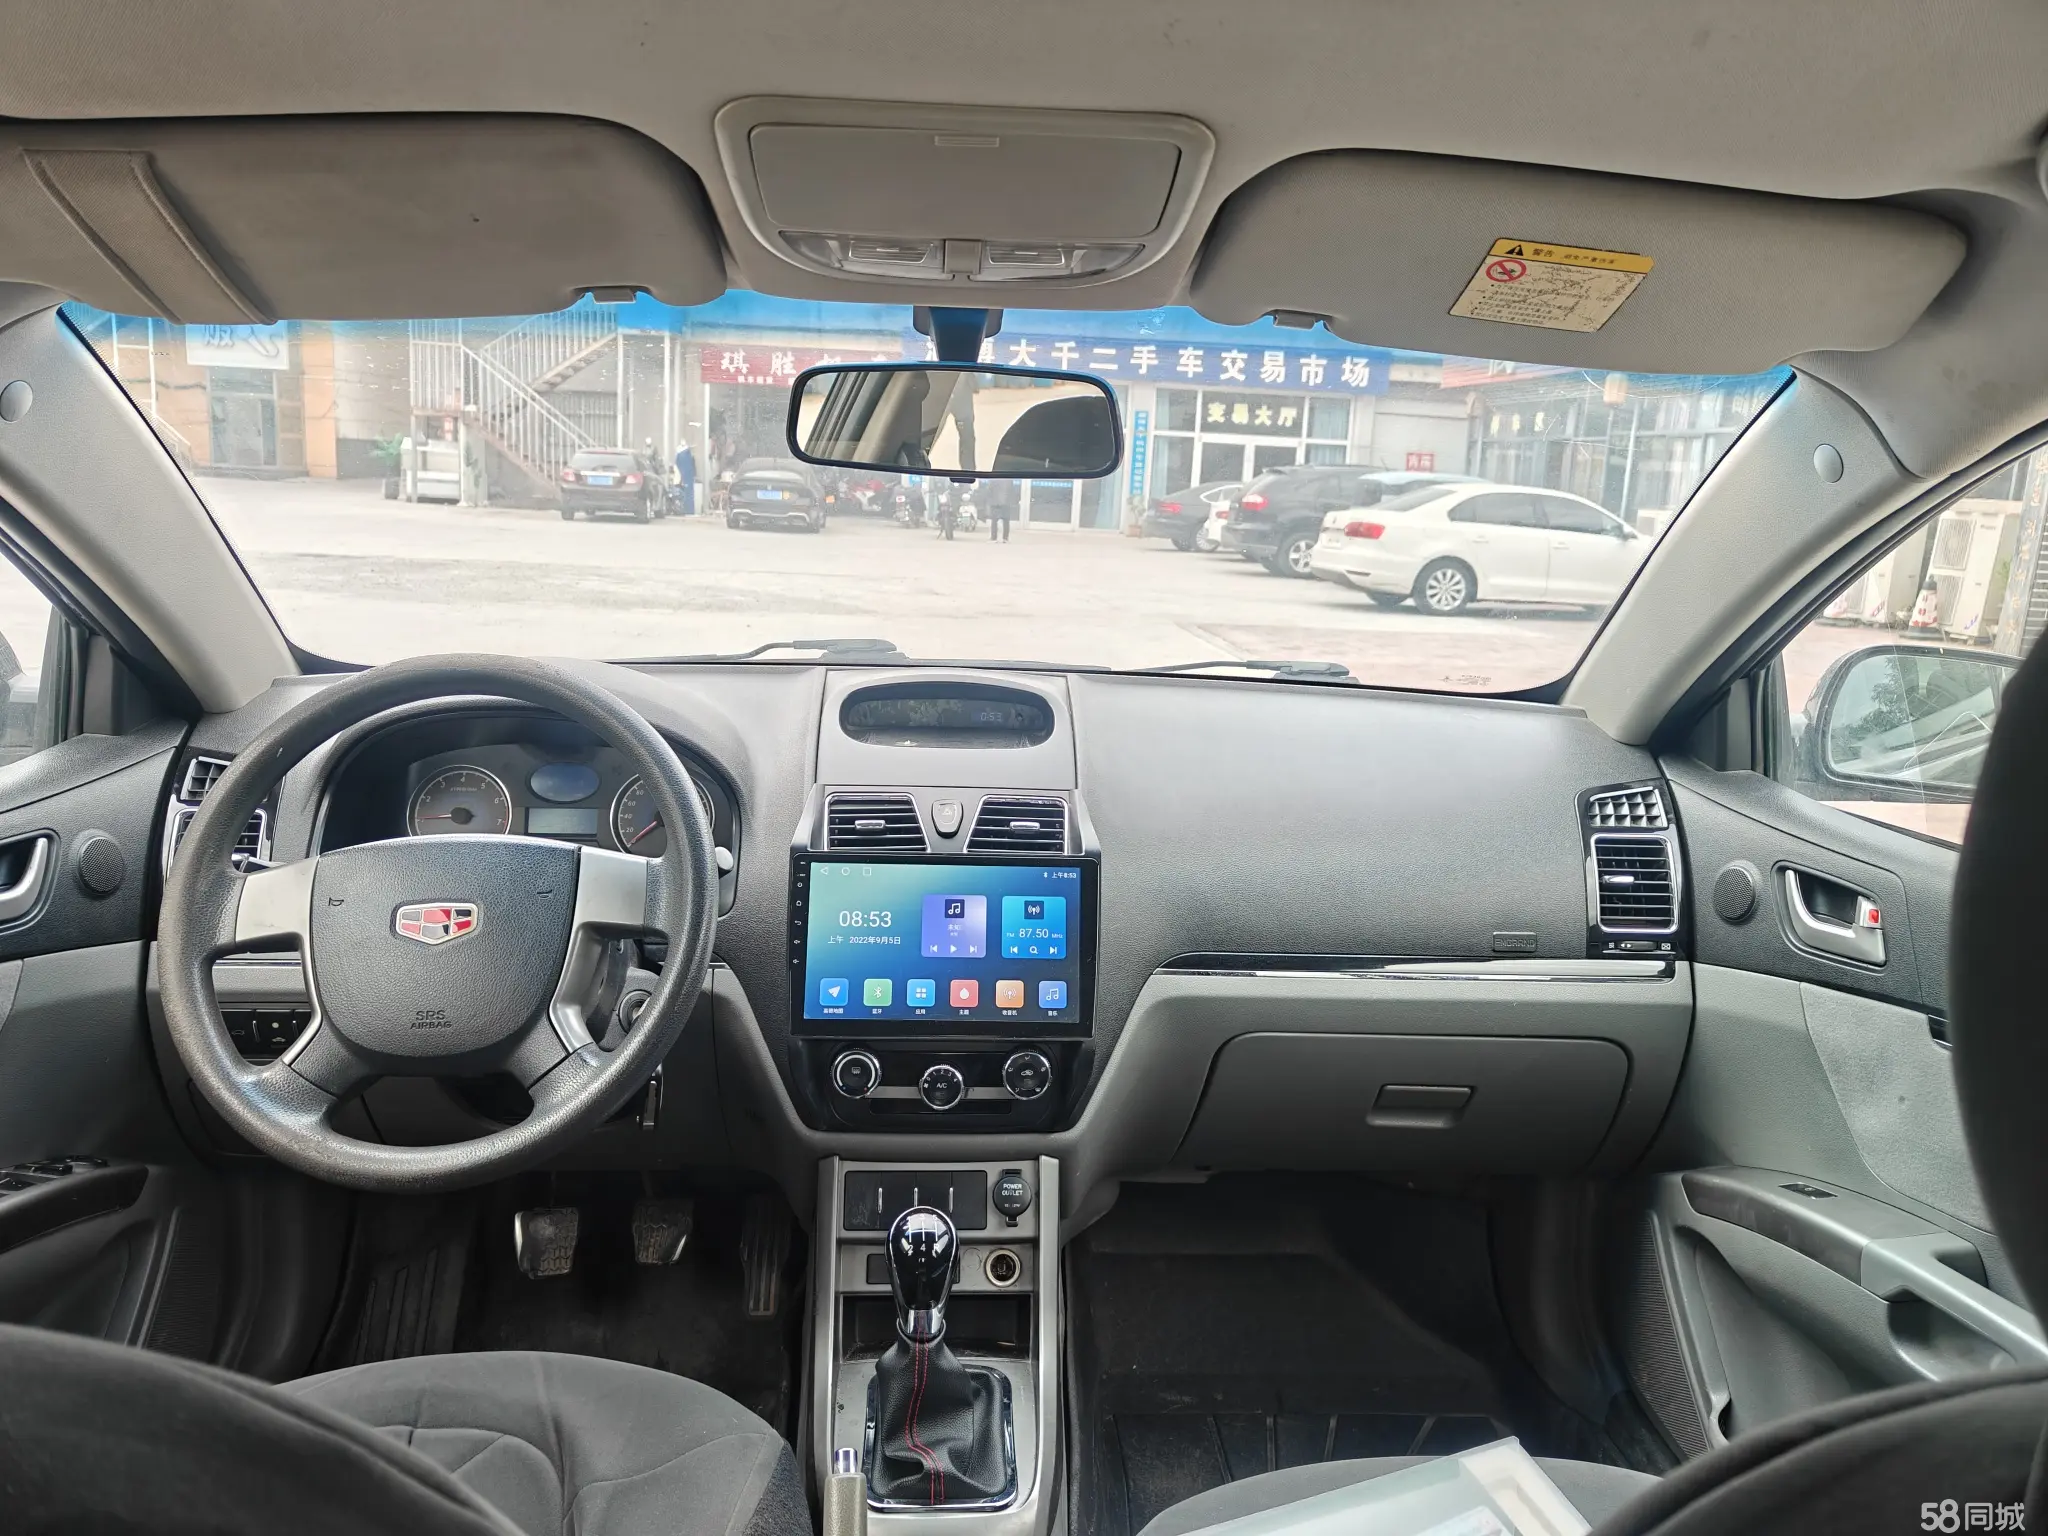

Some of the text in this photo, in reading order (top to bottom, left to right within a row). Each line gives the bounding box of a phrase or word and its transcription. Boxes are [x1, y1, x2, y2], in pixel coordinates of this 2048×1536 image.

[1207, 402, 1298, 427] 交易大厅
[839, 910, 892, 927] 08:53
[1019, 928, 1049, 938] 87.50
[827, 935, 901, 945] 上午 2022年9月5日
[415, 1010, 446, 1021] SRS
[410, 1021, 453, 1030] AIRBAG
